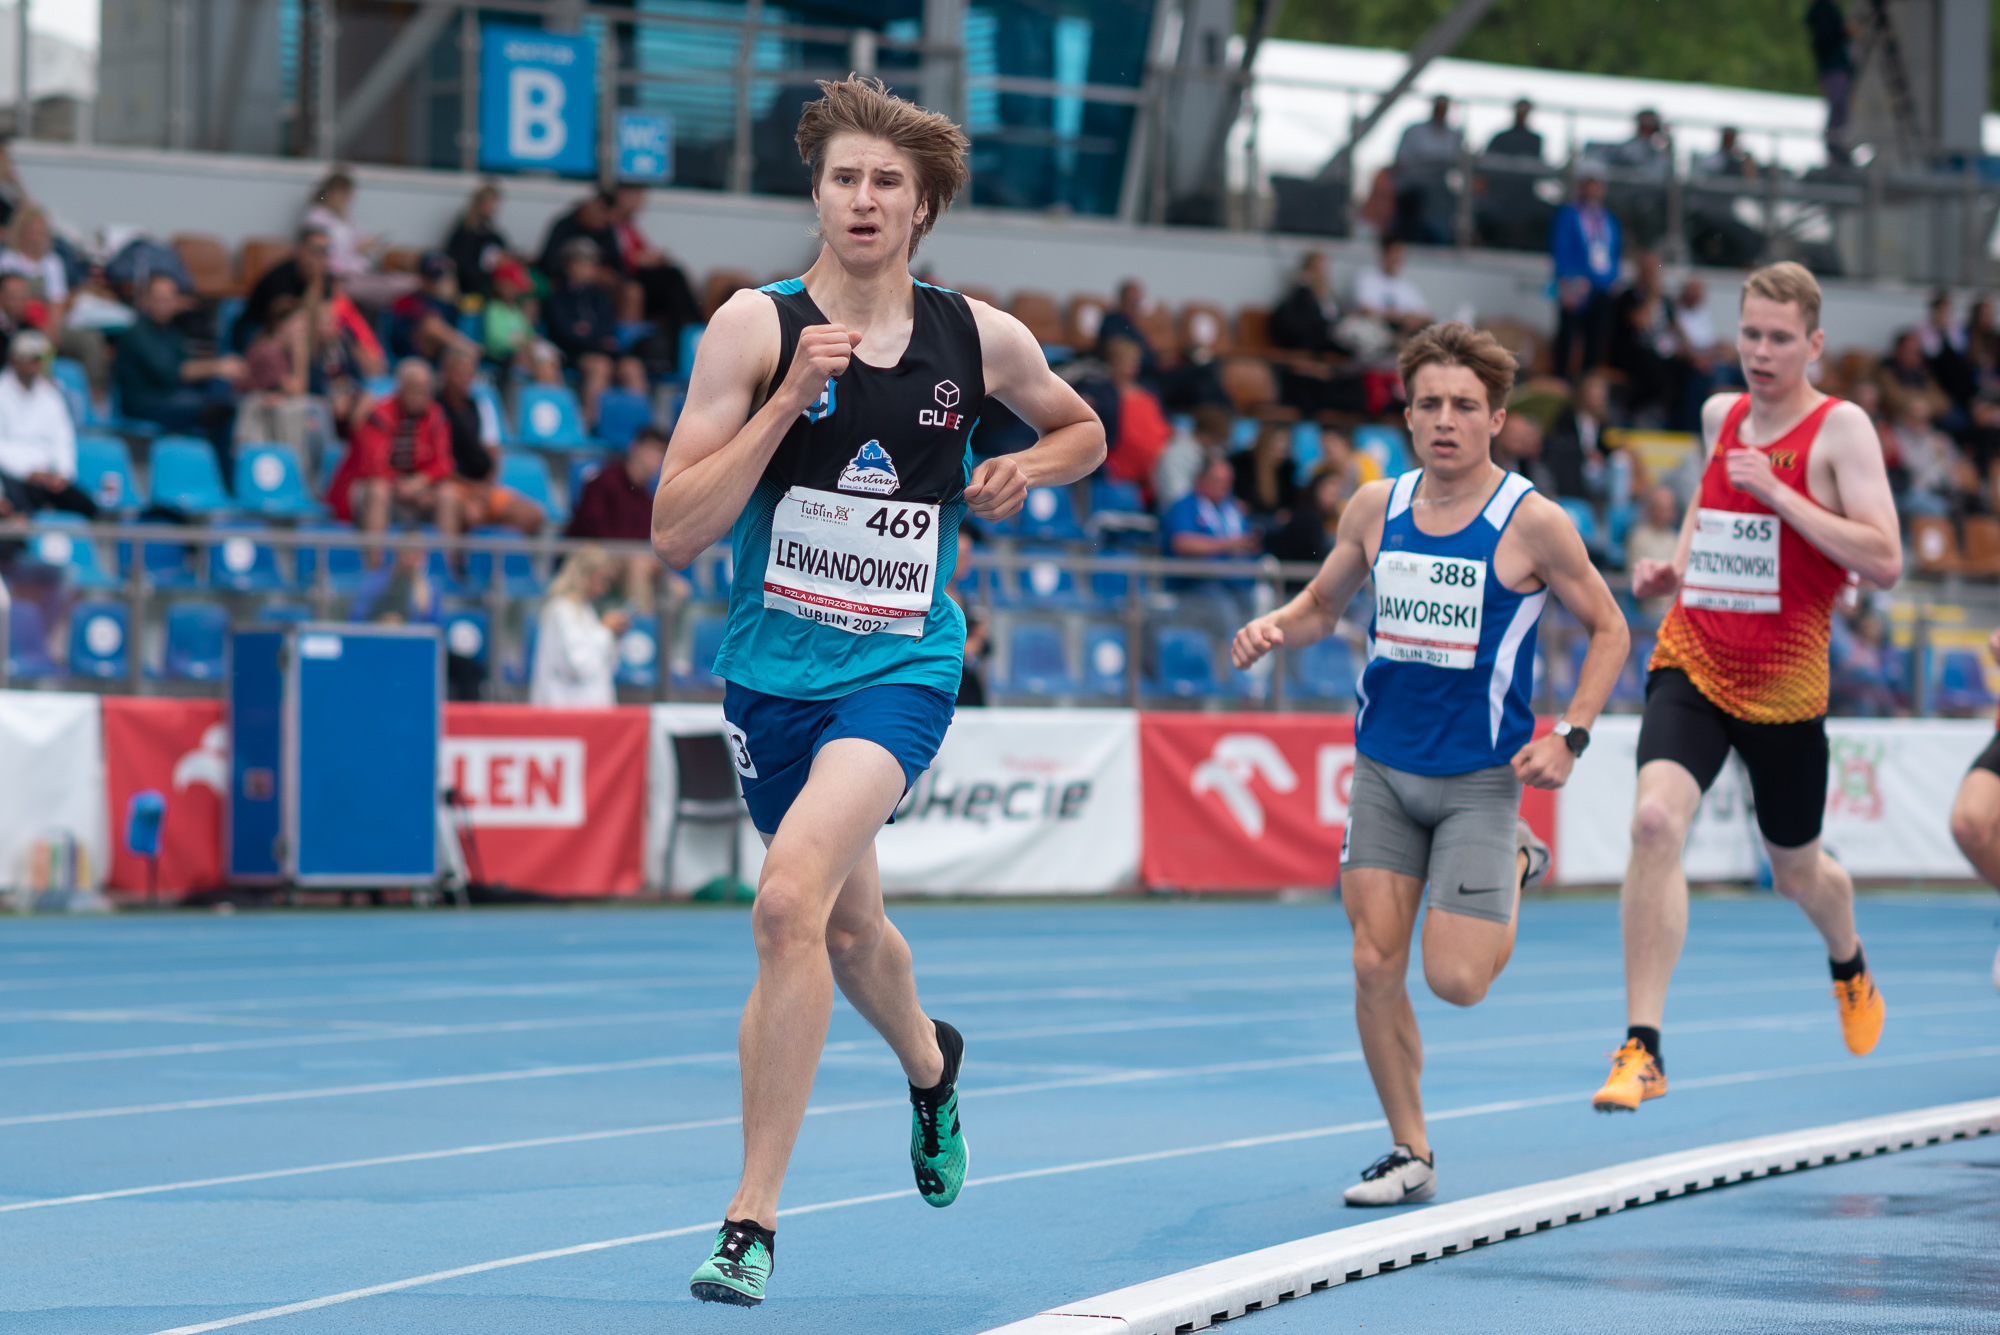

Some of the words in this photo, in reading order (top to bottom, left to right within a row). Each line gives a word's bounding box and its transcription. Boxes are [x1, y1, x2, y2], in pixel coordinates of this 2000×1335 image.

[509, 67, 568, 160] B
[919, 409, 964, 431] CUBE
[840, 466, 899, 495] Kartuzy
[866, 507, 931, 540] 469
[1732, 519, 1772, 542] 565
[775, 538, 929, 593] LEWANDOWSKI
[1430, 562, 1477, 588] 388
[1690, 551, 1775, 579] PIETRZYKOWSKI
[784, 588, 807, 600] PZLA
[807, 594, 870, 613] MISTRZOSTWA
[871, 607, 902, 617] POLSKI
[797, 604, 849, 627] LUBLIN
[1379, 595, 1477, 628] JAWORSKI
[1390, 645, 1422, 659] LUBLIN
[1425, 649, 1449, 663] 2021
[453, 755, 564, 808] LEN
